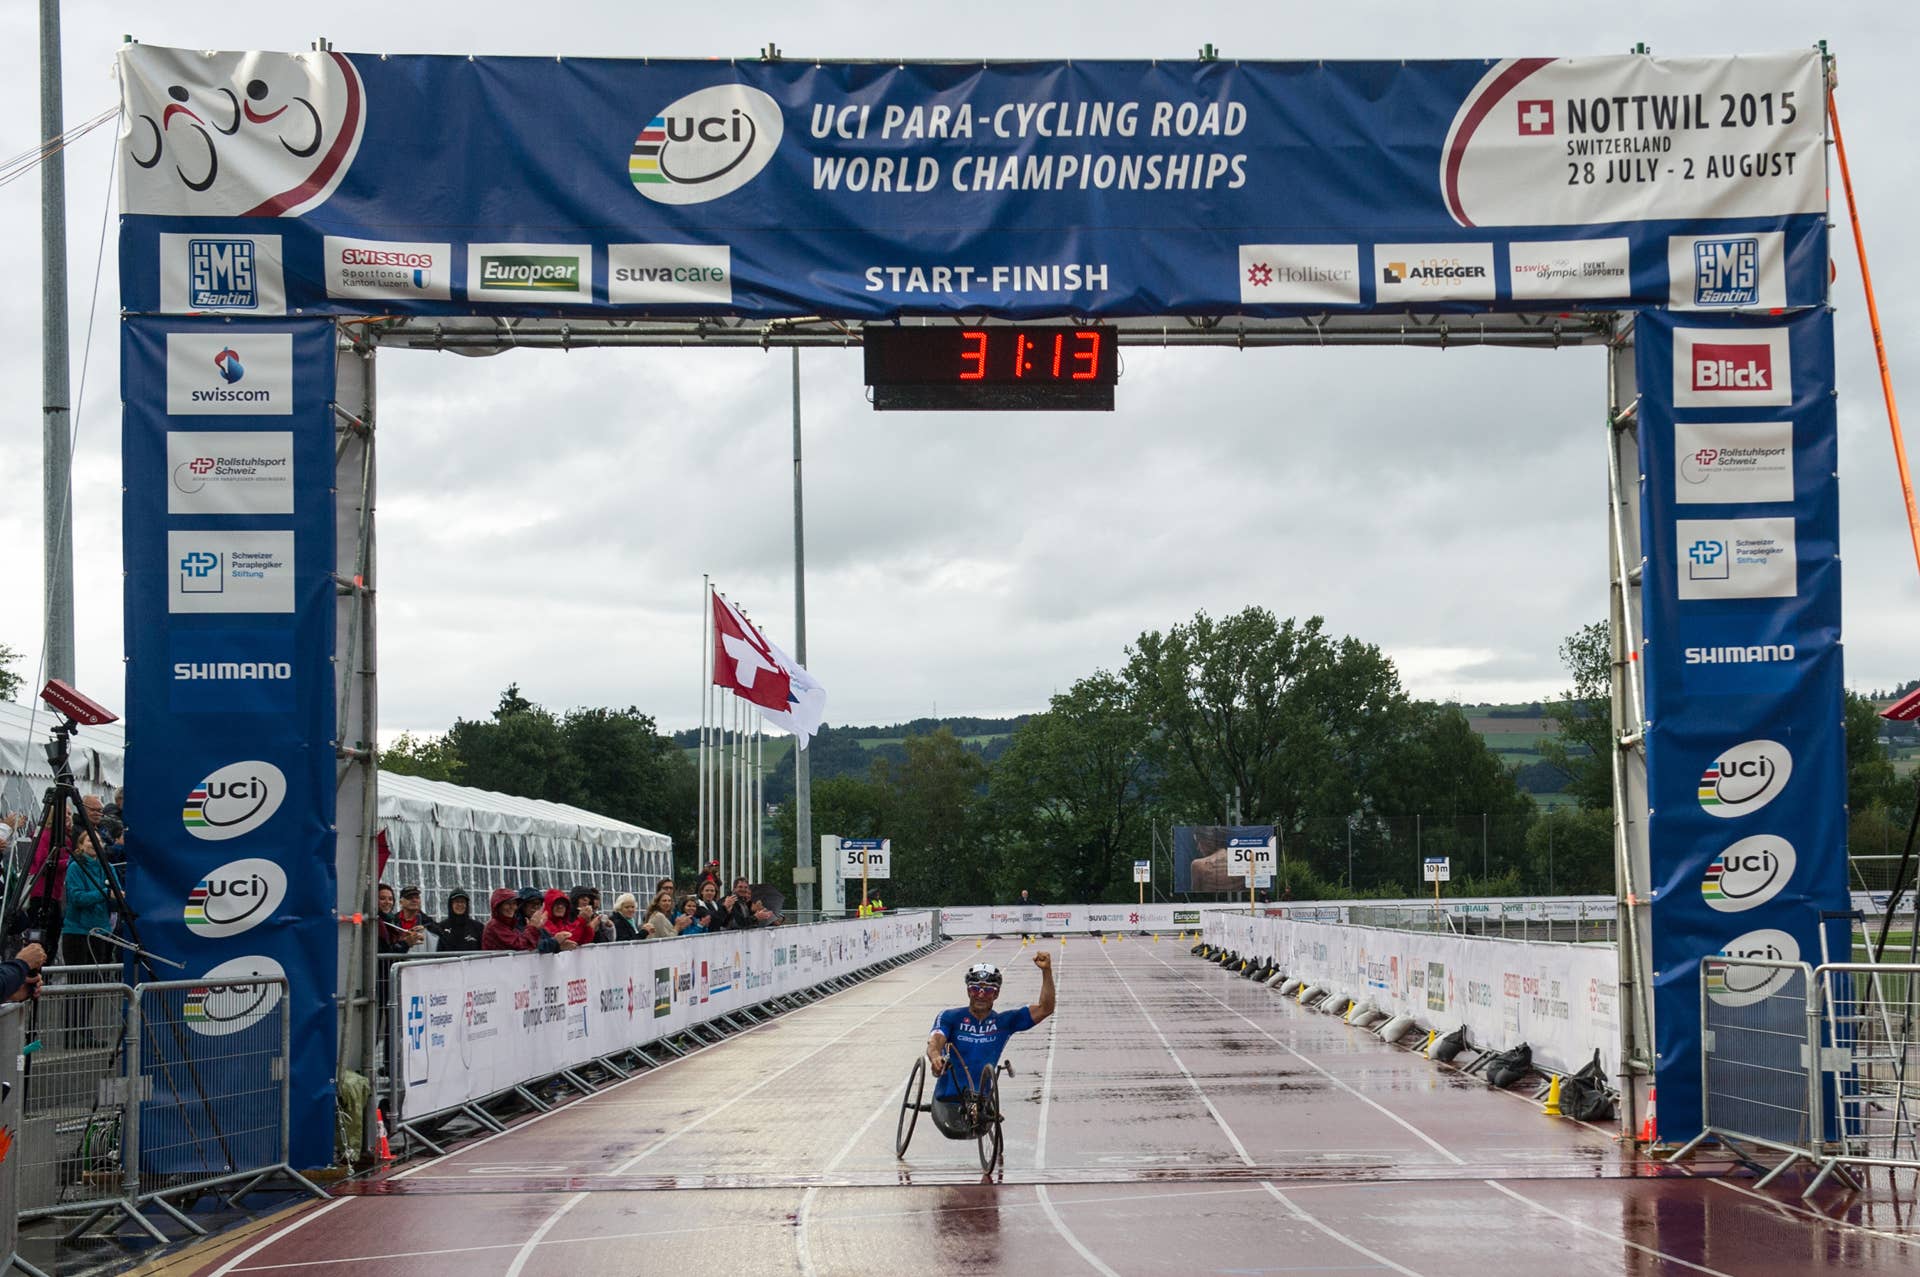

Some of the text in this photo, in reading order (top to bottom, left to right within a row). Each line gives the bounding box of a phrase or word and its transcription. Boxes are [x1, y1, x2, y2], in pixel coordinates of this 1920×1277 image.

[1567, 91, 1797, 134] NOTTWIL 2015
[810, 101, 1247, 140] UCI PARA-CYCLING ROAD
[1567, 136, 1672, 157] SWITZERLAND
[812, 153, 1247, 193] WORLD CHAMPIONSHIPS
[1567, 161, 1596, 185] 28
[1606, 159, 1659, 184] JULY
[1683, 158, 1695, 180] 2
[1706, 152, 1797, 180] AUGUST
[342, 249, 432, 268] SWISSLOS
[1700, 242, 1754, 289] SMS
[193, 242, 250, 291] SMS
[342, 268, 409, 280] Sportfonds
[484, 261, 577, 286] Europcar
[616, 265, 724, 283] suvacare
[1410, 266, 1486, 279] AREGGER
[1537, 267, 1577, 280] olympic
[1583, 268, 1625, 277] SUPPORTER
[865, 264, 1109, 294] START-FINISH
[1277, 266, 1351, 283] Hollister
[343, 278, 409, 289] Kanton Luzern
[195, 291, 251, 306] Santini
[1700, 289, 1754, 303] Santini
[960, 331, 1100, 380] 31:13
[1696, 360, 1767, 387] Blick
[192, 387, 270, 402] swisscom
[1719, 447, 1786, 458] Rollstuhlsport
[216, 457, 286, 468] Rollstuhlsport
[1718, 457, 1758, 466] Schweiz
[215, 466, 257, 475] Schweiz
[231, 551, 273, 560] Schweizer
[231, 560, 283, 570] Paraplegiker
[231, 570, 264, 579] Stiftung
[1684, 644, 1795, 664] SHIMANO
[174, 662, 292, 680] SHIMANO
[848, 851, 866, 864] 50
[1234, 849, 1253, 862] 50
[959, 1022, 998, 1035] ITALIA
